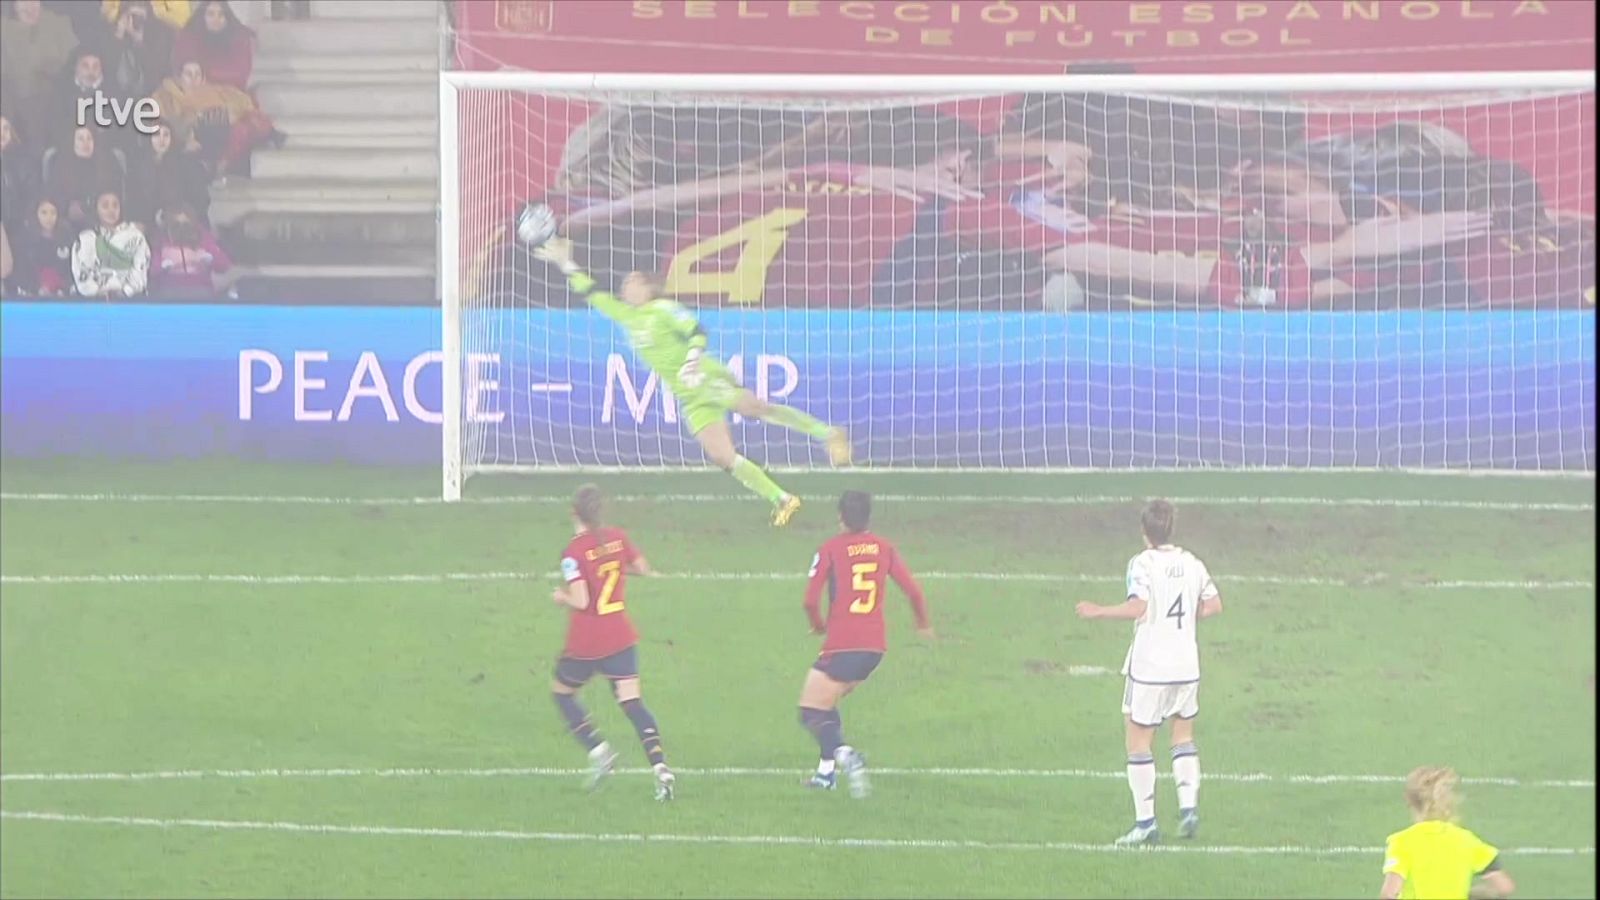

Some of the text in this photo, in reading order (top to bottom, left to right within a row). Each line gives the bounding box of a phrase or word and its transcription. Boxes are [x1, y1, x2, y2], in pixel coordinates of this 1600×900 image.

[631, 1, 1077, 25] SELECCIÓN
[864, 24, 1313, 48] DE FÚTBOL
[664, 206, 809, 303] 4
[237, 348, 506, 423] PEACE
[595, 559, 626, 616] 2
[848, 561, 879, 615] 5
[1166, 593, 1186, 629] 4
